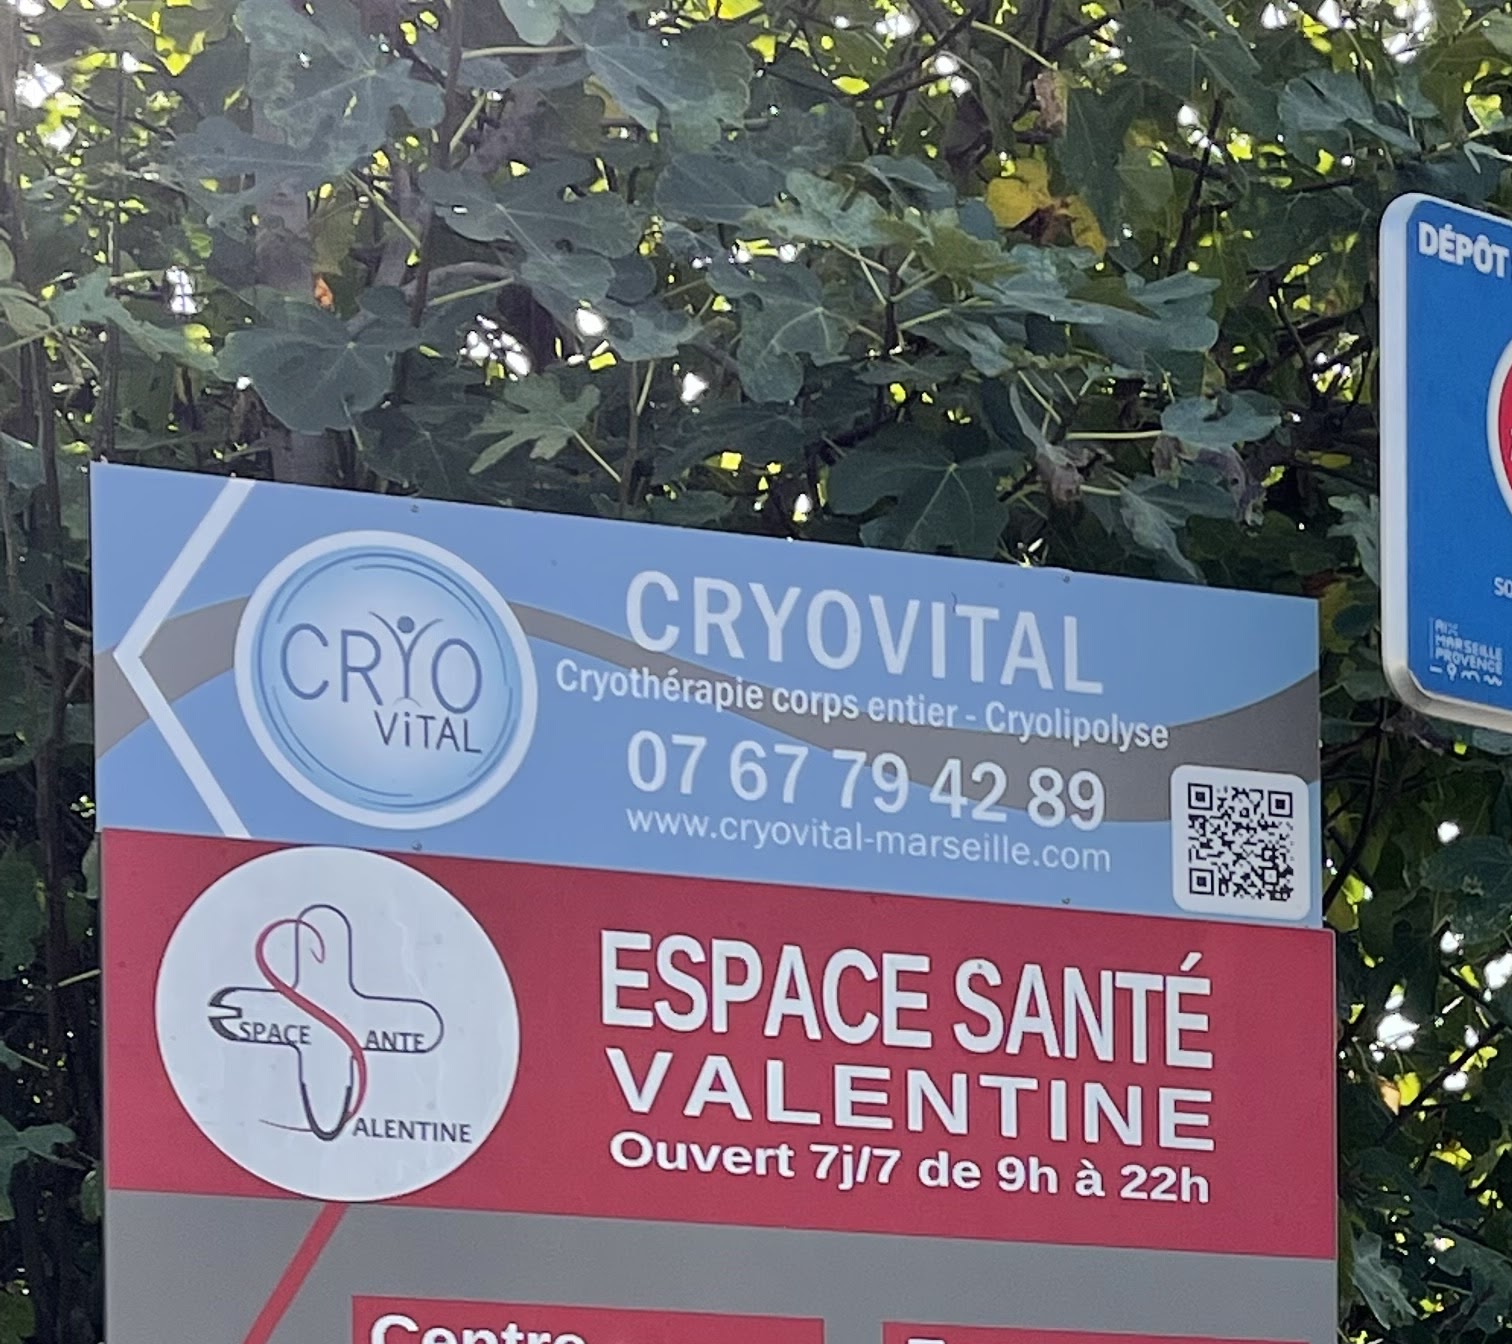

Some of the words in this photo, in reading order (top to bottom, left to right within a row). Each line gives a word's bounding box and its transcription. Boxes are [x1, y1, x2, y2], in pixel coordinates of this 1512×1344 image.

[1418, 221, 1510, 278] DÉPÔT
[280, 611, 482, 714] CRYO
[625, 571, 1104, 694] CRYOVITAL
[1435, 634, 1503, 661] MARSEILLE
[1435, 646, 1503, 675] PROVENCE
[555, 659, 763, 712] Cryothérapie
[772, 690, 858, 723] corps
[868, 692, 957, 730] entier
[985, 701, 1169, 752] Cryolipolyse
[627, 729, 708, 795] 07
[729, 739, 809, 803] 67
[834, 748, 908, 814] 79
[929, 758, 1008, 825] 42
[1027, 767, 1106, 832] 89
[626, 806, 1110, 873] www.cryovital-marseille.com
[601, 929, 932, 1049] ESPACE
[954, 952, 1213, 1069] SANTÉ
[605, 1047, 1214, 1151] VALENTINE
[609, 1129, 795, 1179] Ouvert
[810, 1144, 901, 1191] 7j/7
[918, 1150, 980, 1189] de
[997, 1156, 1058, 1194] 9h
[1076, 1158, 1105, 1197] à
[1119, 1162, 1210, 1203] 22h
